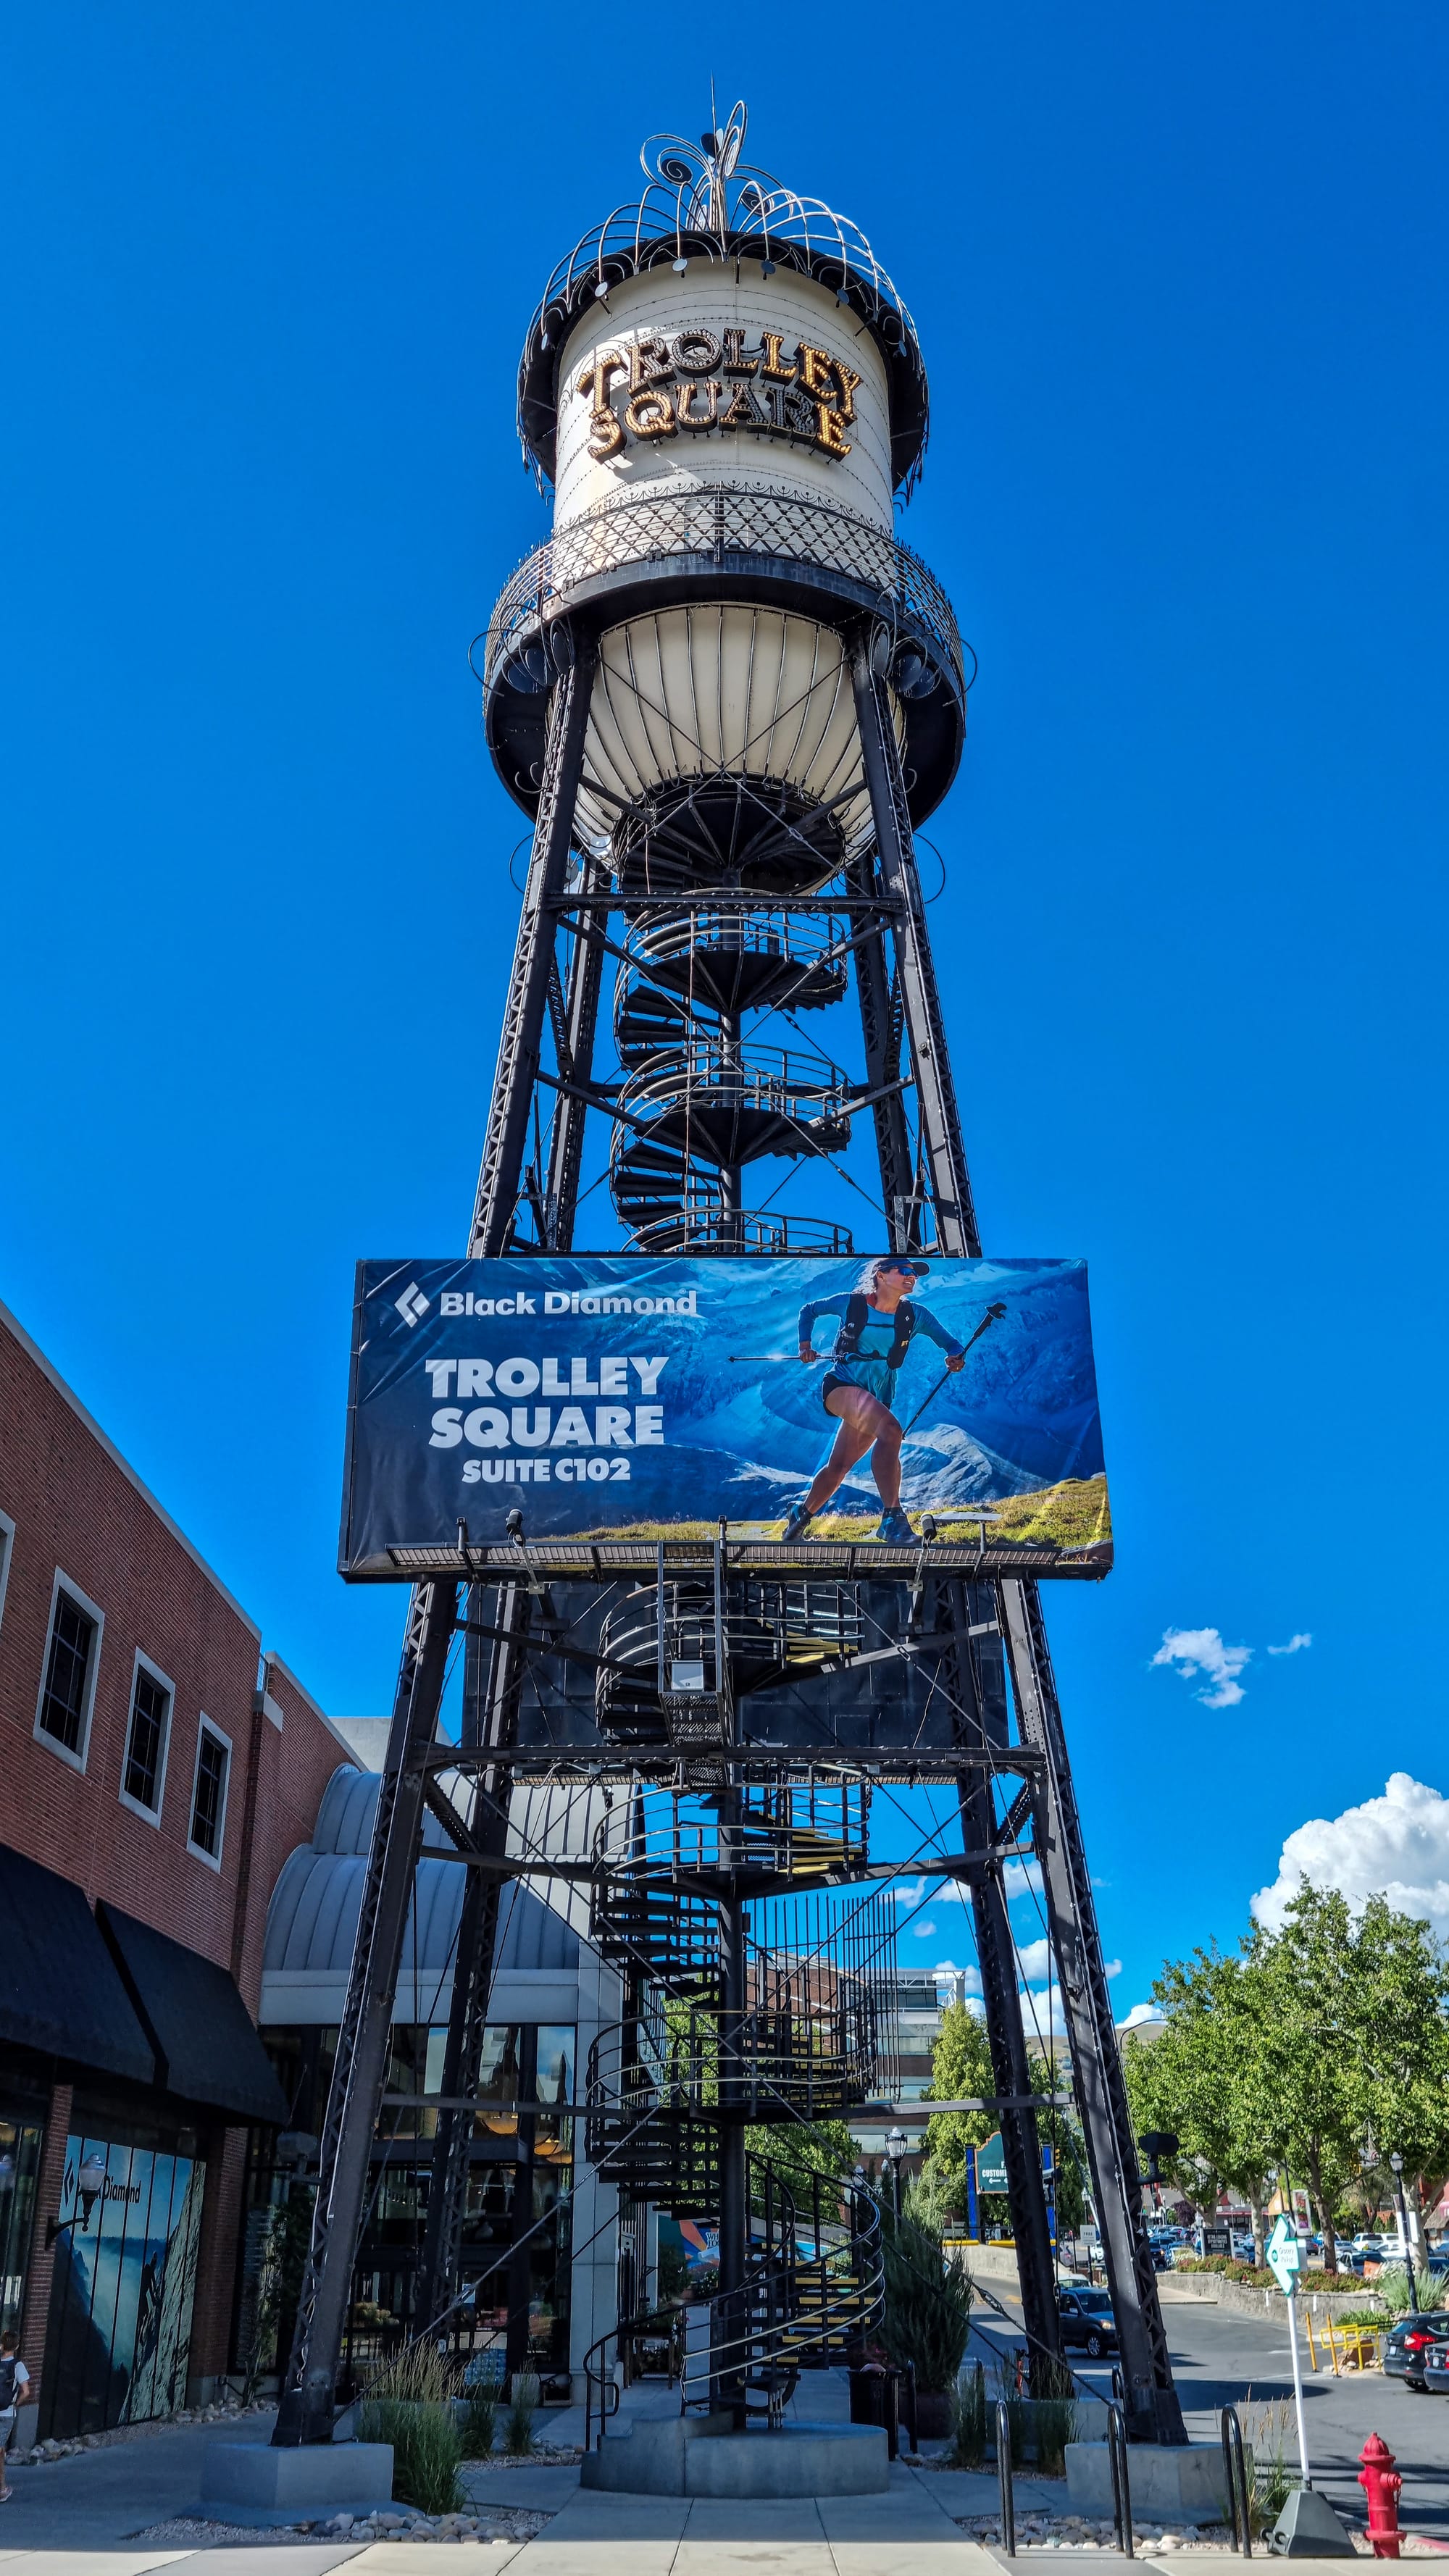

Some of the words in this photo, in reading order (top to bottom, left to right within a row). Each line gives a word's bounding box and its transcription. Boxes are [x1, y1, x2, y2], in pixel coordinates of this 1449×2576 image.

[577, 327, 864, 426] TROLLEY
[588, 381, 852, 464] SQUARE
[440, 1291, 537, 1316] Black
[544, 1290, 697, 1315] Diamond
[425, 1356, 669, 1398] TROLLEY
[428, 1405, 665, 1450] SQUARE
[461, 1458, 551, 1484] SUITE
[554, 1458, 631, 1481] C102
[982, 2169, 1008, 2178] CUSTOM
